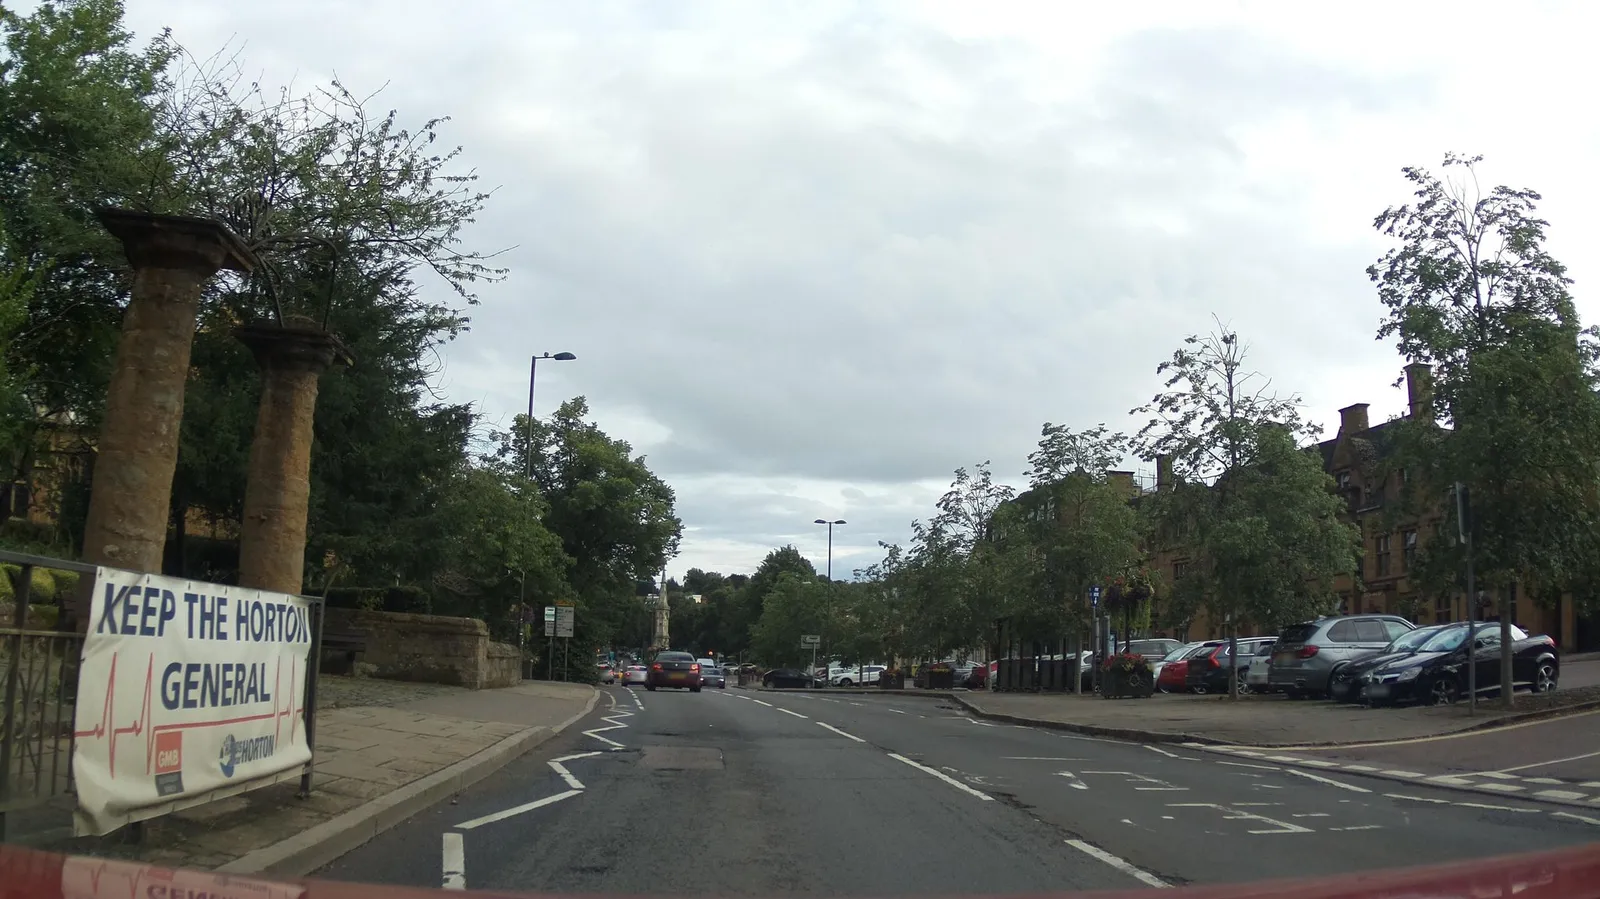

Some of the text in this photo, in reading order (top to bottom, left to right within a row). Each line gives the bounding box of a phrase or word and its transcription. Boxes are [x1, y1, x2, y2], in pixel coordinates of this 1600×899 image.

[96, 583, 308, 643] KEEP THE HORTON
[161, 662, 271, 710] GENERAL
[158, 749, 179, 768] GMB
[241, 734, 275, 763] HORTON
